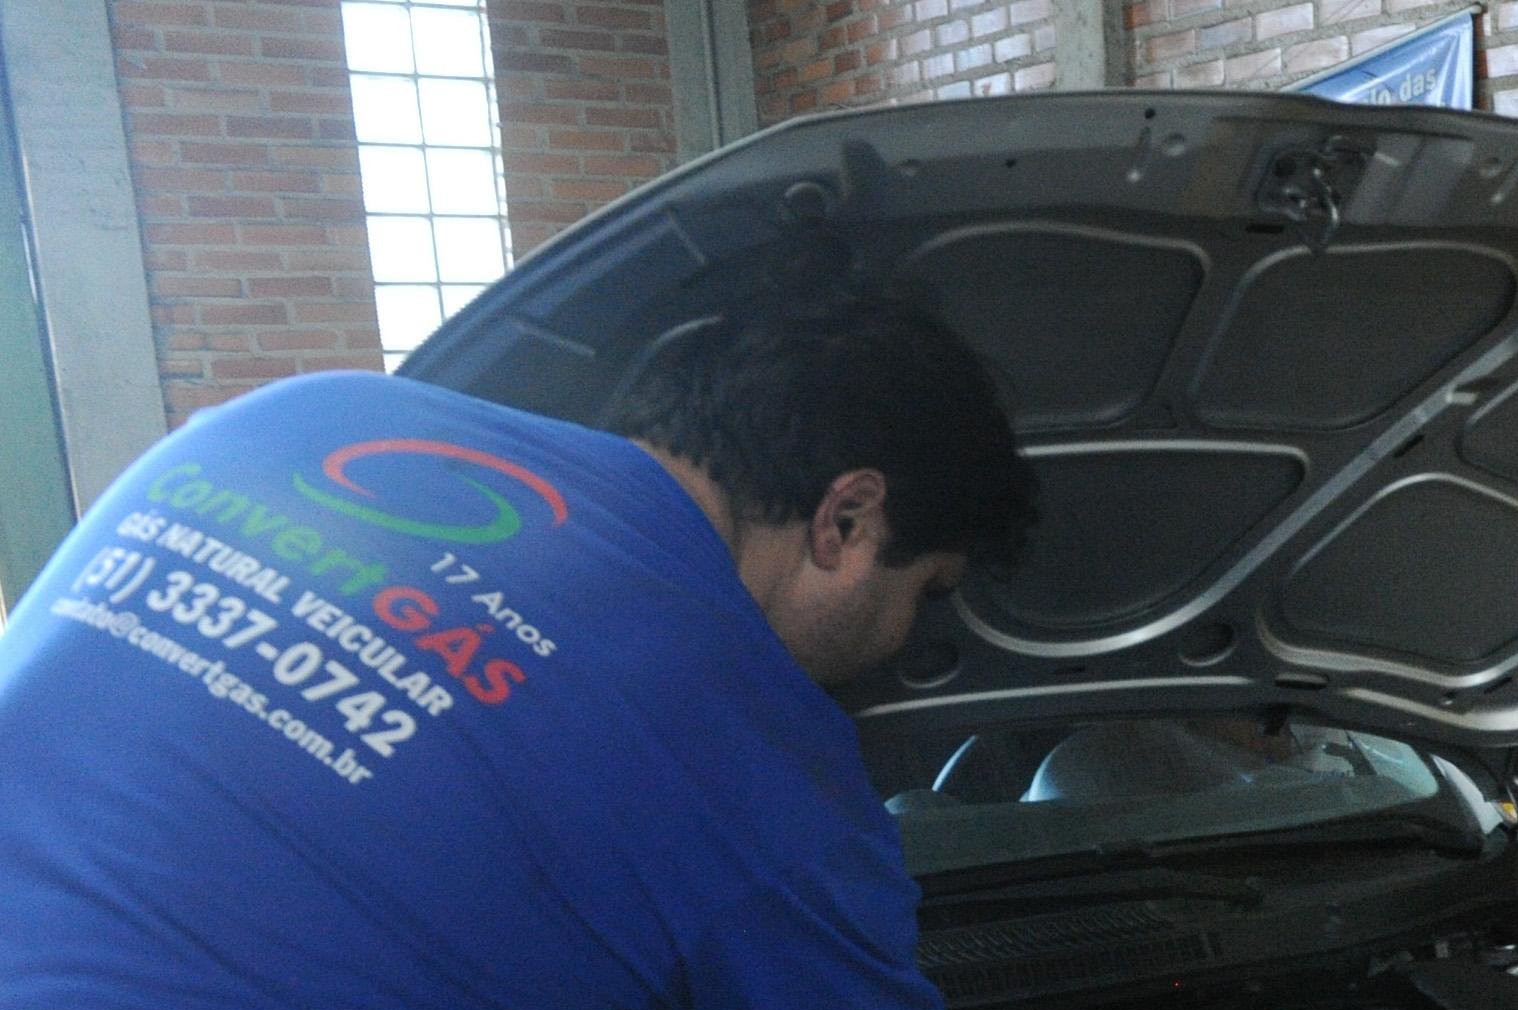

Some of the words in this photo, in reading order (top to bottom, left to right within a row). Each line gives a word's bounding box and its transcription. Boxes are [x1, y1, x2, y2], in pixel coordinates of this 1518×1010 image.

[1400, 69, 1437, 101] das
[146, 571, 417, 758] 3337-0742
[155, 522, 291, 604] NATURAL
[291, 590, 455, 717] VEICULAR
[430, 552, 480, 585] 17
[471, 590, 558, 658] Anos
